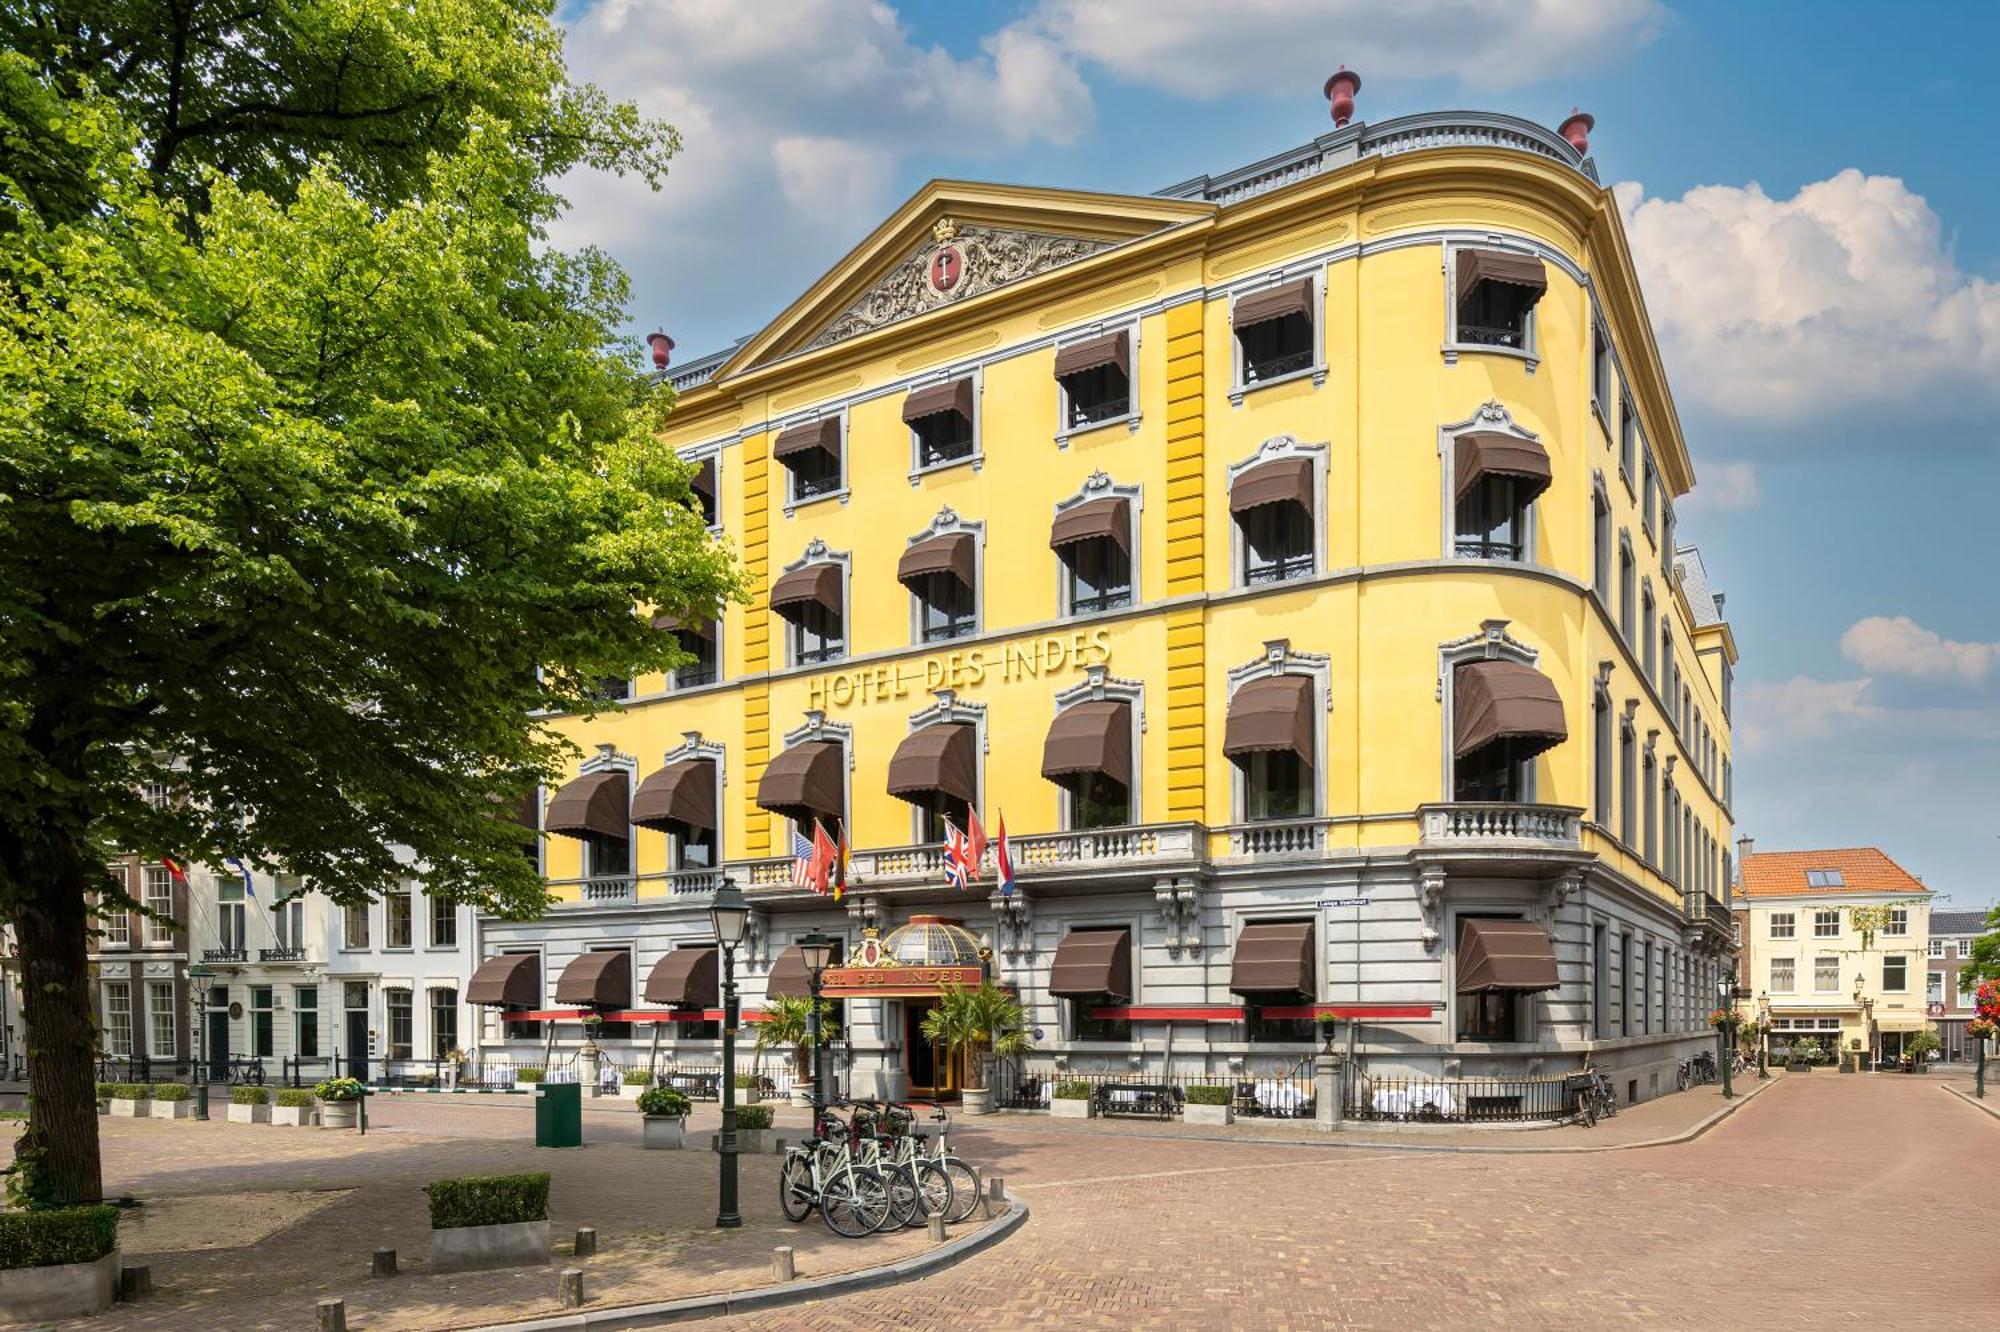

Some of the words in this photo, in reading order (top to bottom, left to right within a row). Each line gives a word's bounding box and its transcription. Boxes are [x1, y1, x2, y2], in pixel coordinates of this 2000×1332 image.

[809, 661, 909, 709] HOTEL
[925, 648, 985, 691] DES
[1002, 627, 1111, 681] INDES
[905, 970, 963, 983] INDES
